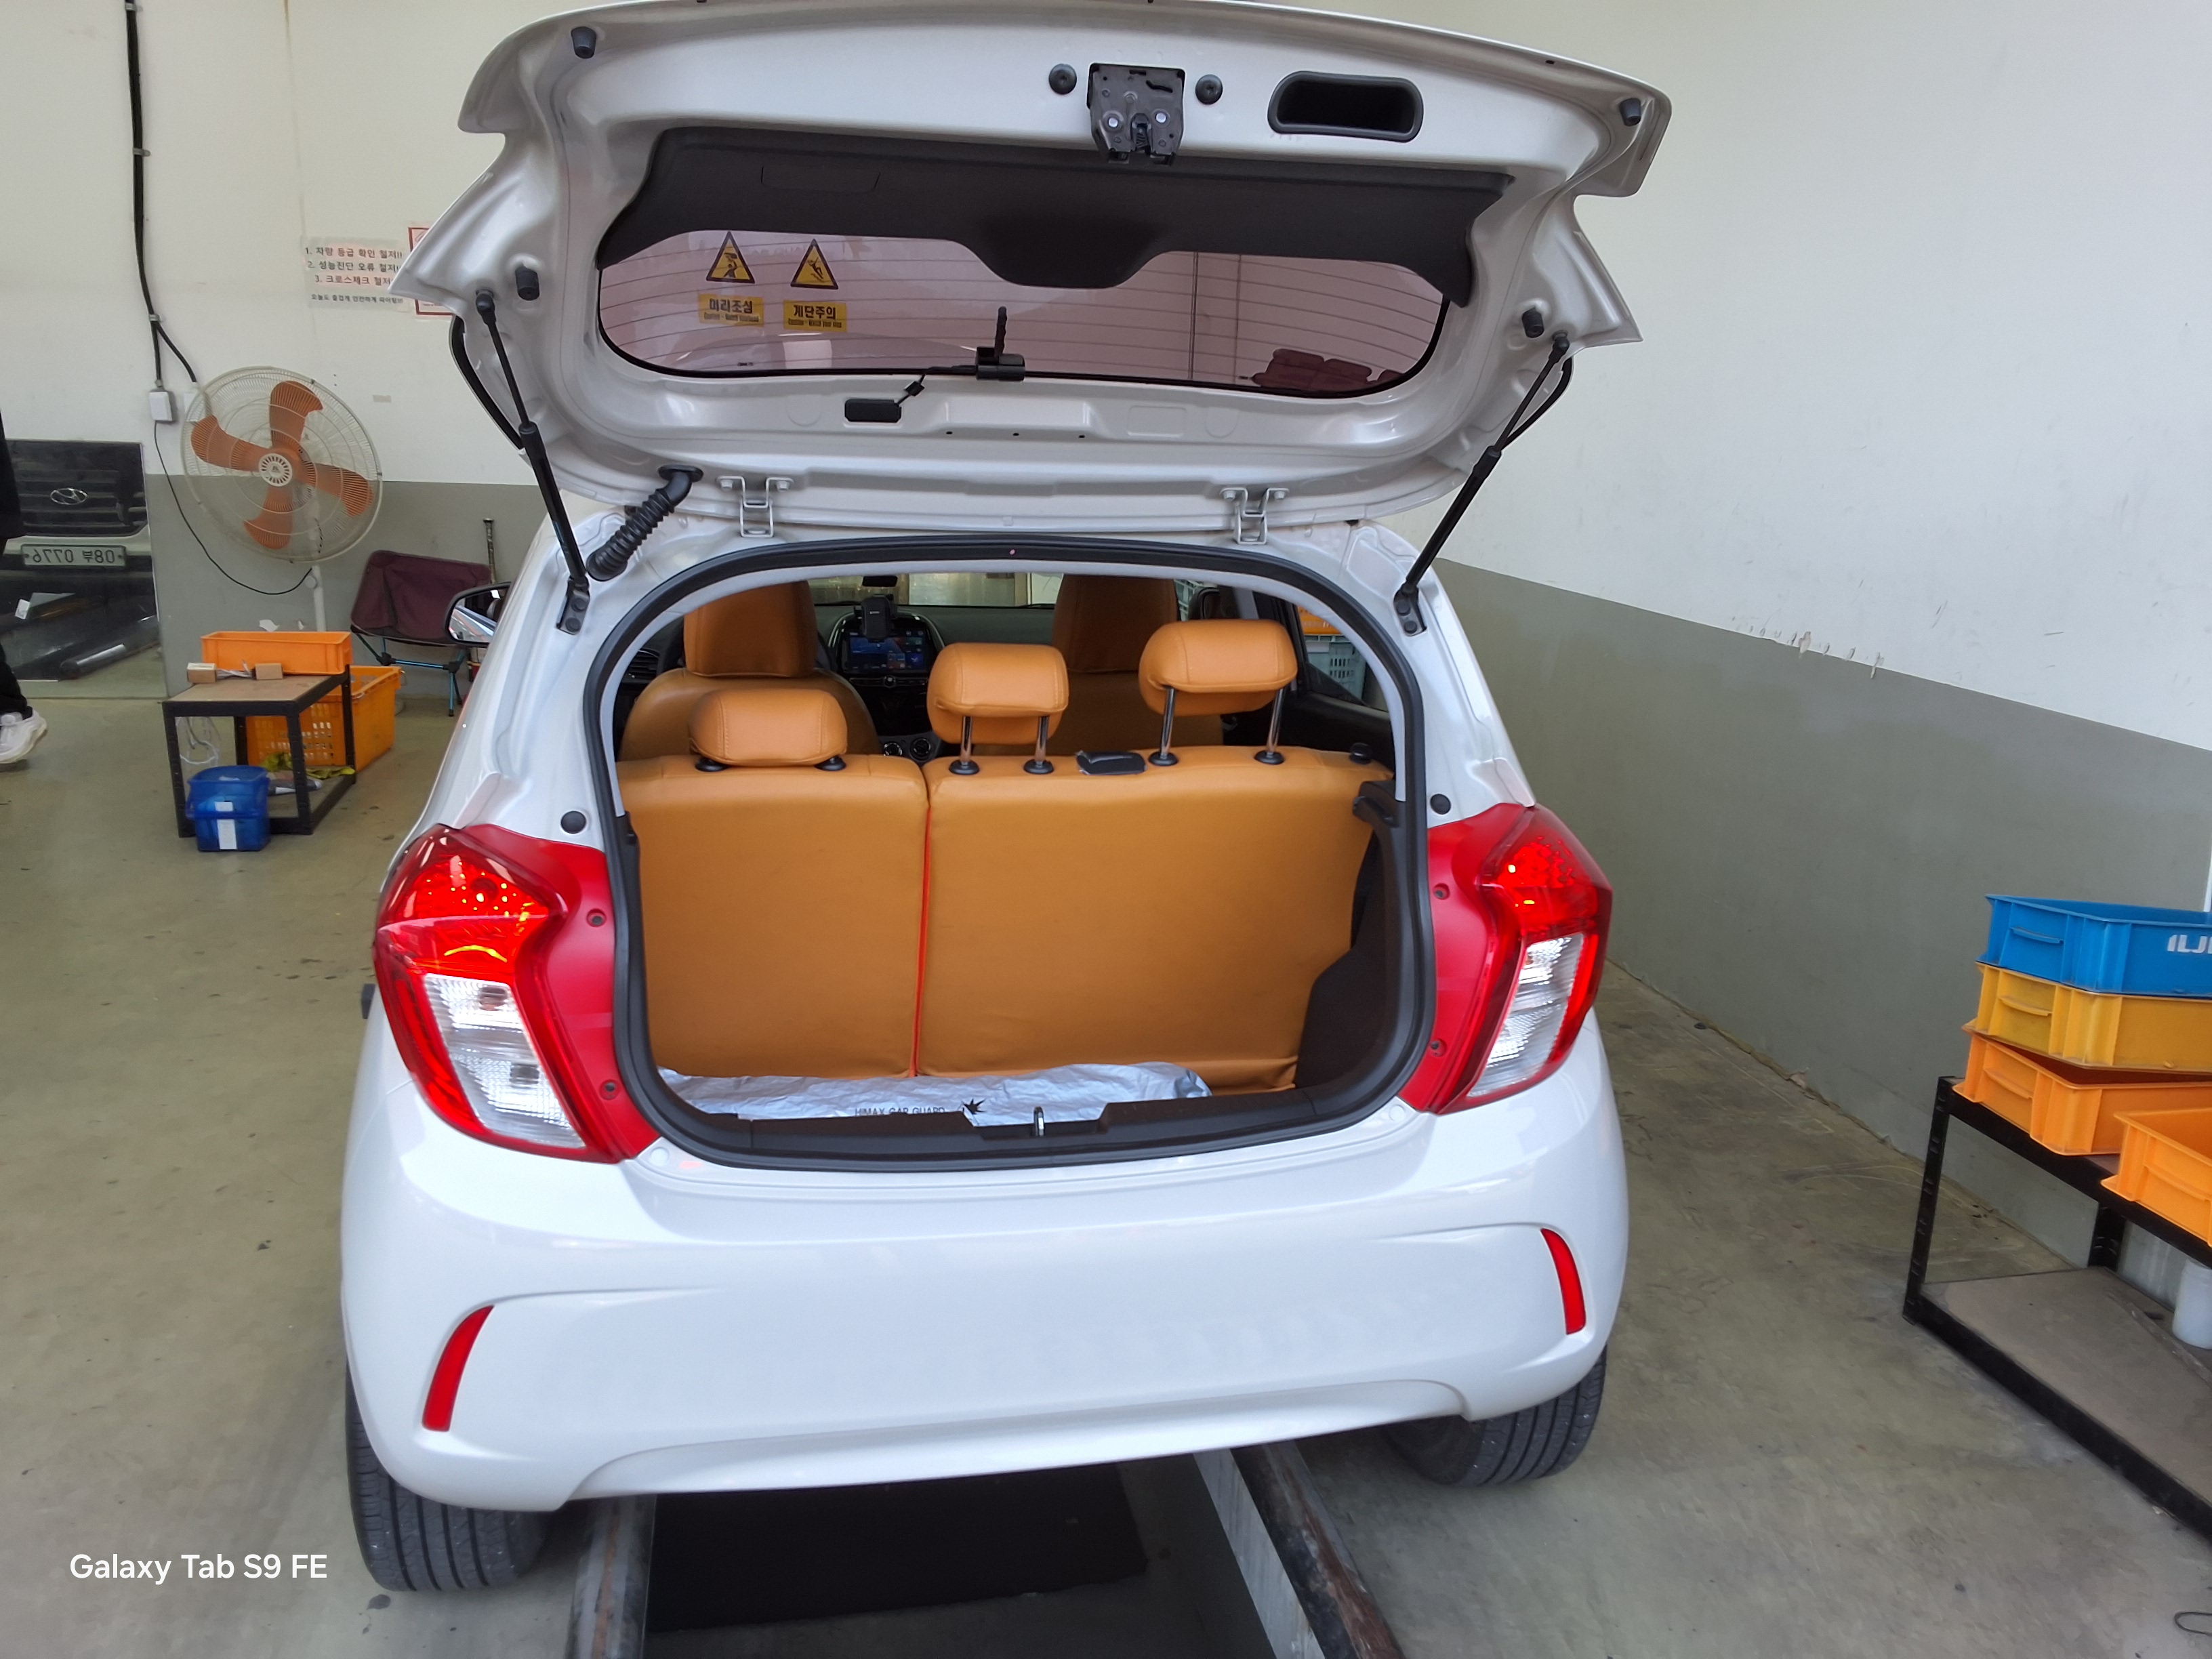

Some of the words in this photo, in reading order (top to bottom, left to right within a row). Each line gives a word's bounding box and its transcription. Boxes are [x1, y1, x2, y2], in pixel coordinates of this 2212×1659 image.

[316, 247, 333, 256] 차량
[338, 247, 354, 258] 등급
[358, 248, 375, 258] 확인
[319, 261, 354, 271] 성능진단
[358, 262, 374, 272] 오류
[326, 275, 370, 285] 크로스체크
[374, 276, 393, 286] 철저
[793, 304, 836, 320] 계단주의
